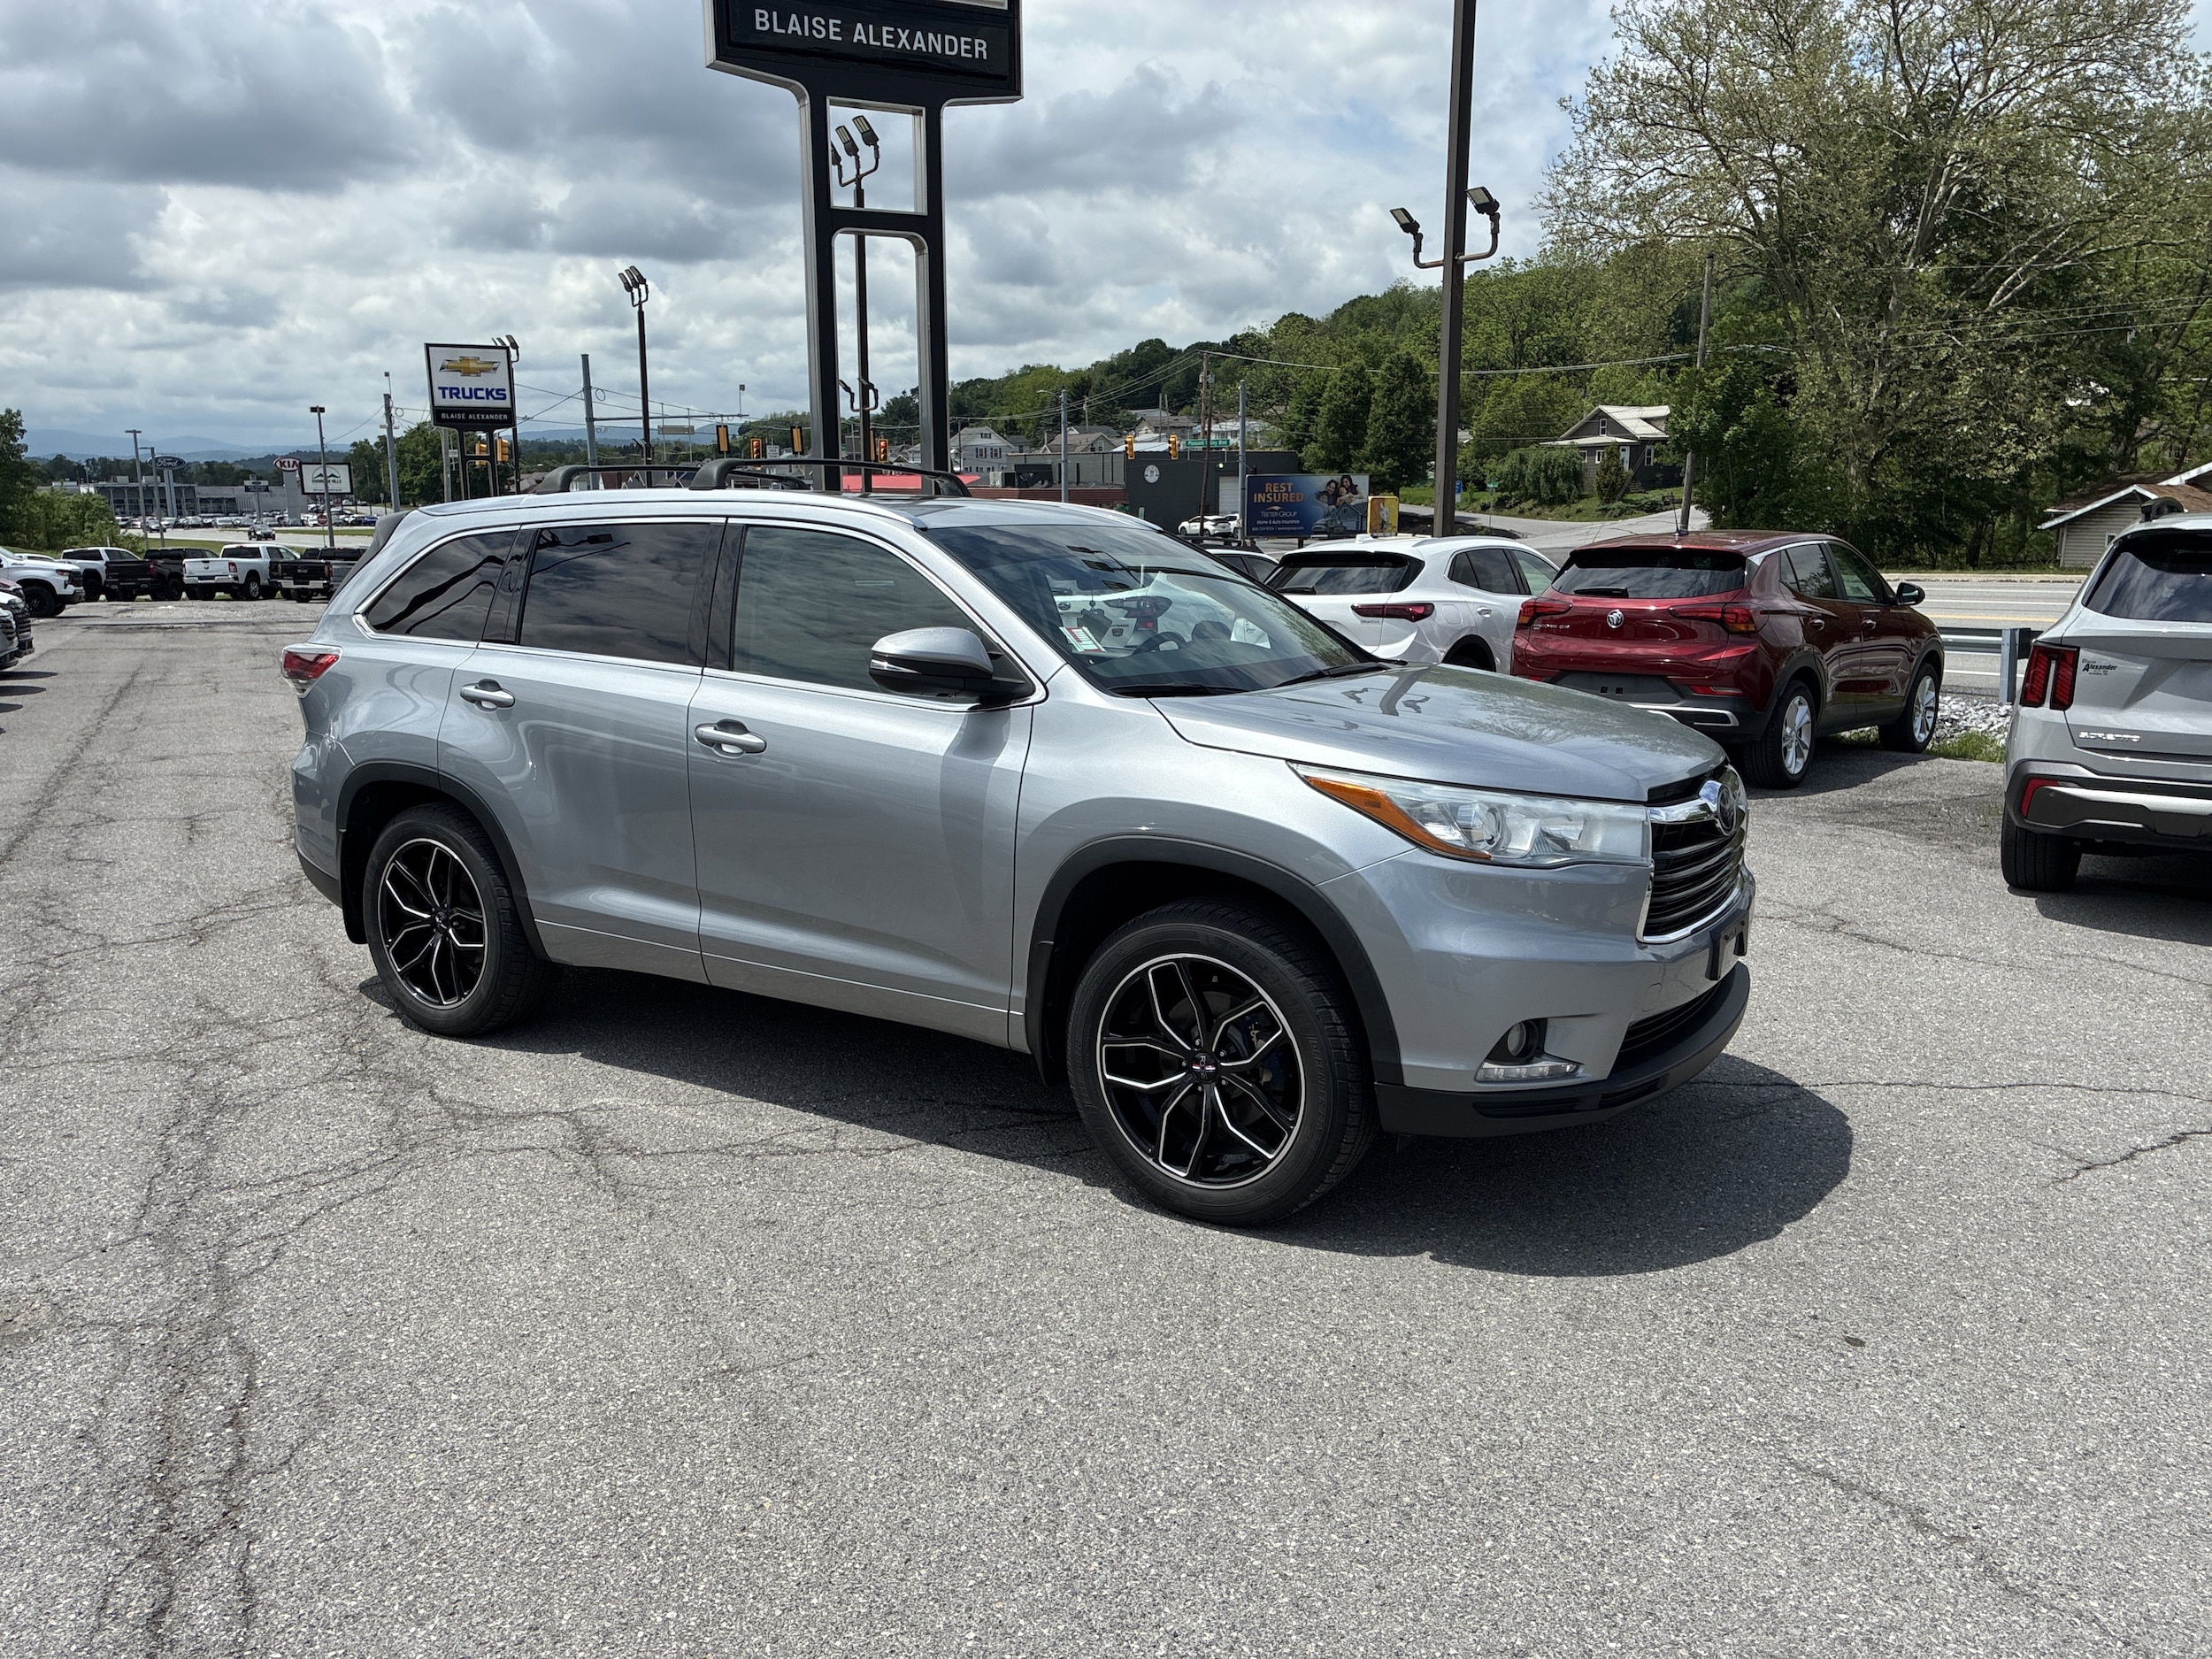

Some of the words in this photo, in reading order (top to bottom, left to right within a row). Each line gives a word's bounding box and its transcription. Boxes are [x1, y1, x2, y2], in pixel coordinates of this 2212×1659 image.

[755, 8, 843, 42] BLAISE
[853, 22, 988, 60] ALEXANDER
[438, 386, 507, 401] TRUCKS
[156, 457, 179, 467] Ford
[1265, 482, 1294, 493] REST
[1253, 493, 1304, 503] INSURED
[2082, 663, 2117, 672] Alexander
[1309, 1039, 1326, 1107] DEFENDER
